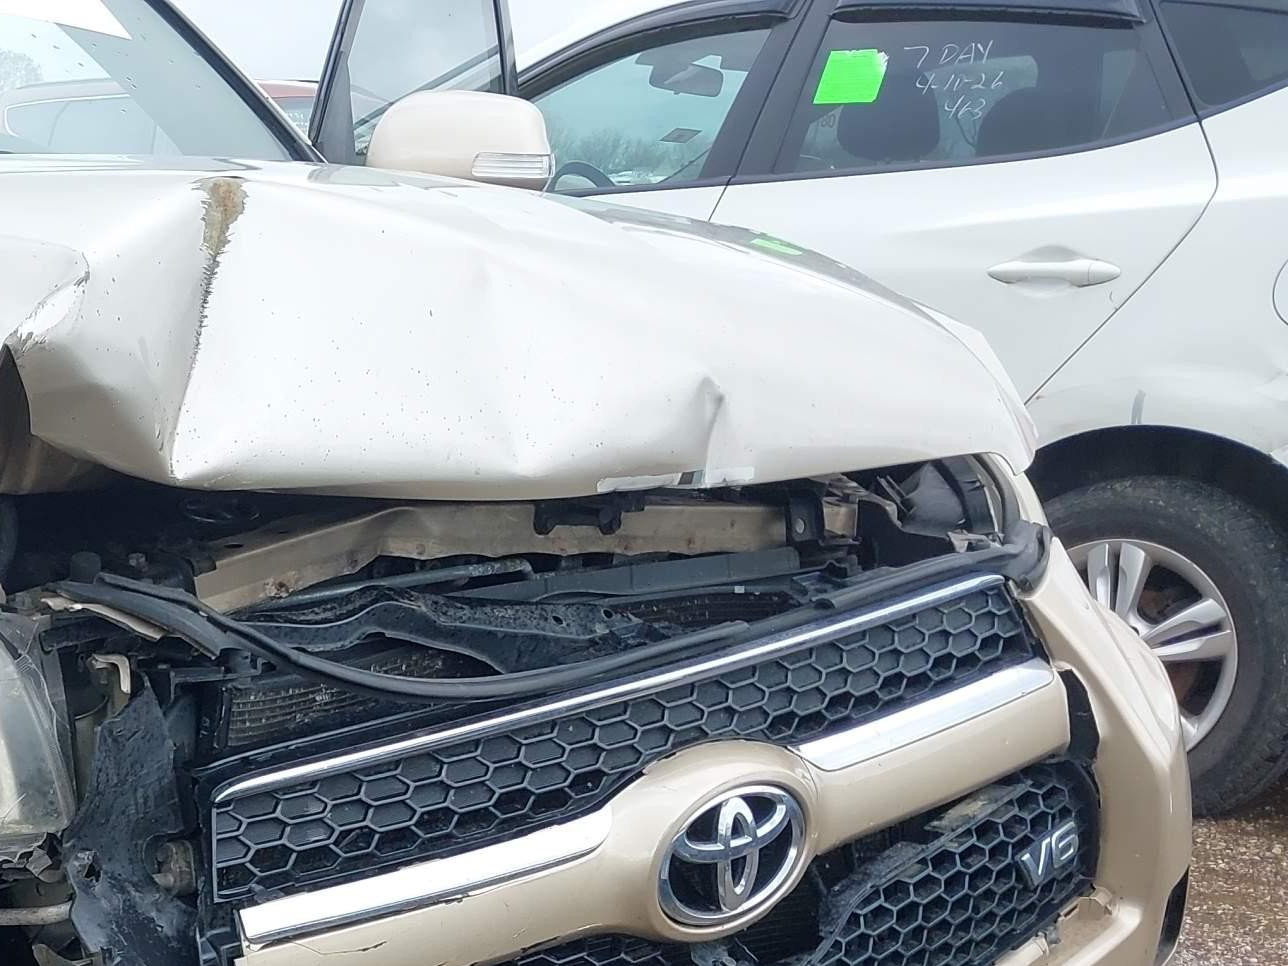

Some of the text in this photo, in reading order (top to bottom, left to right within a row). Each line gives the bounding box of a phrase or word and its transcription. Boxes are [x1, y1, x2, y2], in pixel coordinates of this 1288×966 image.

[903, 39, 994, 69] 7 DAY
[1016, 819, 1079, 885] V6
